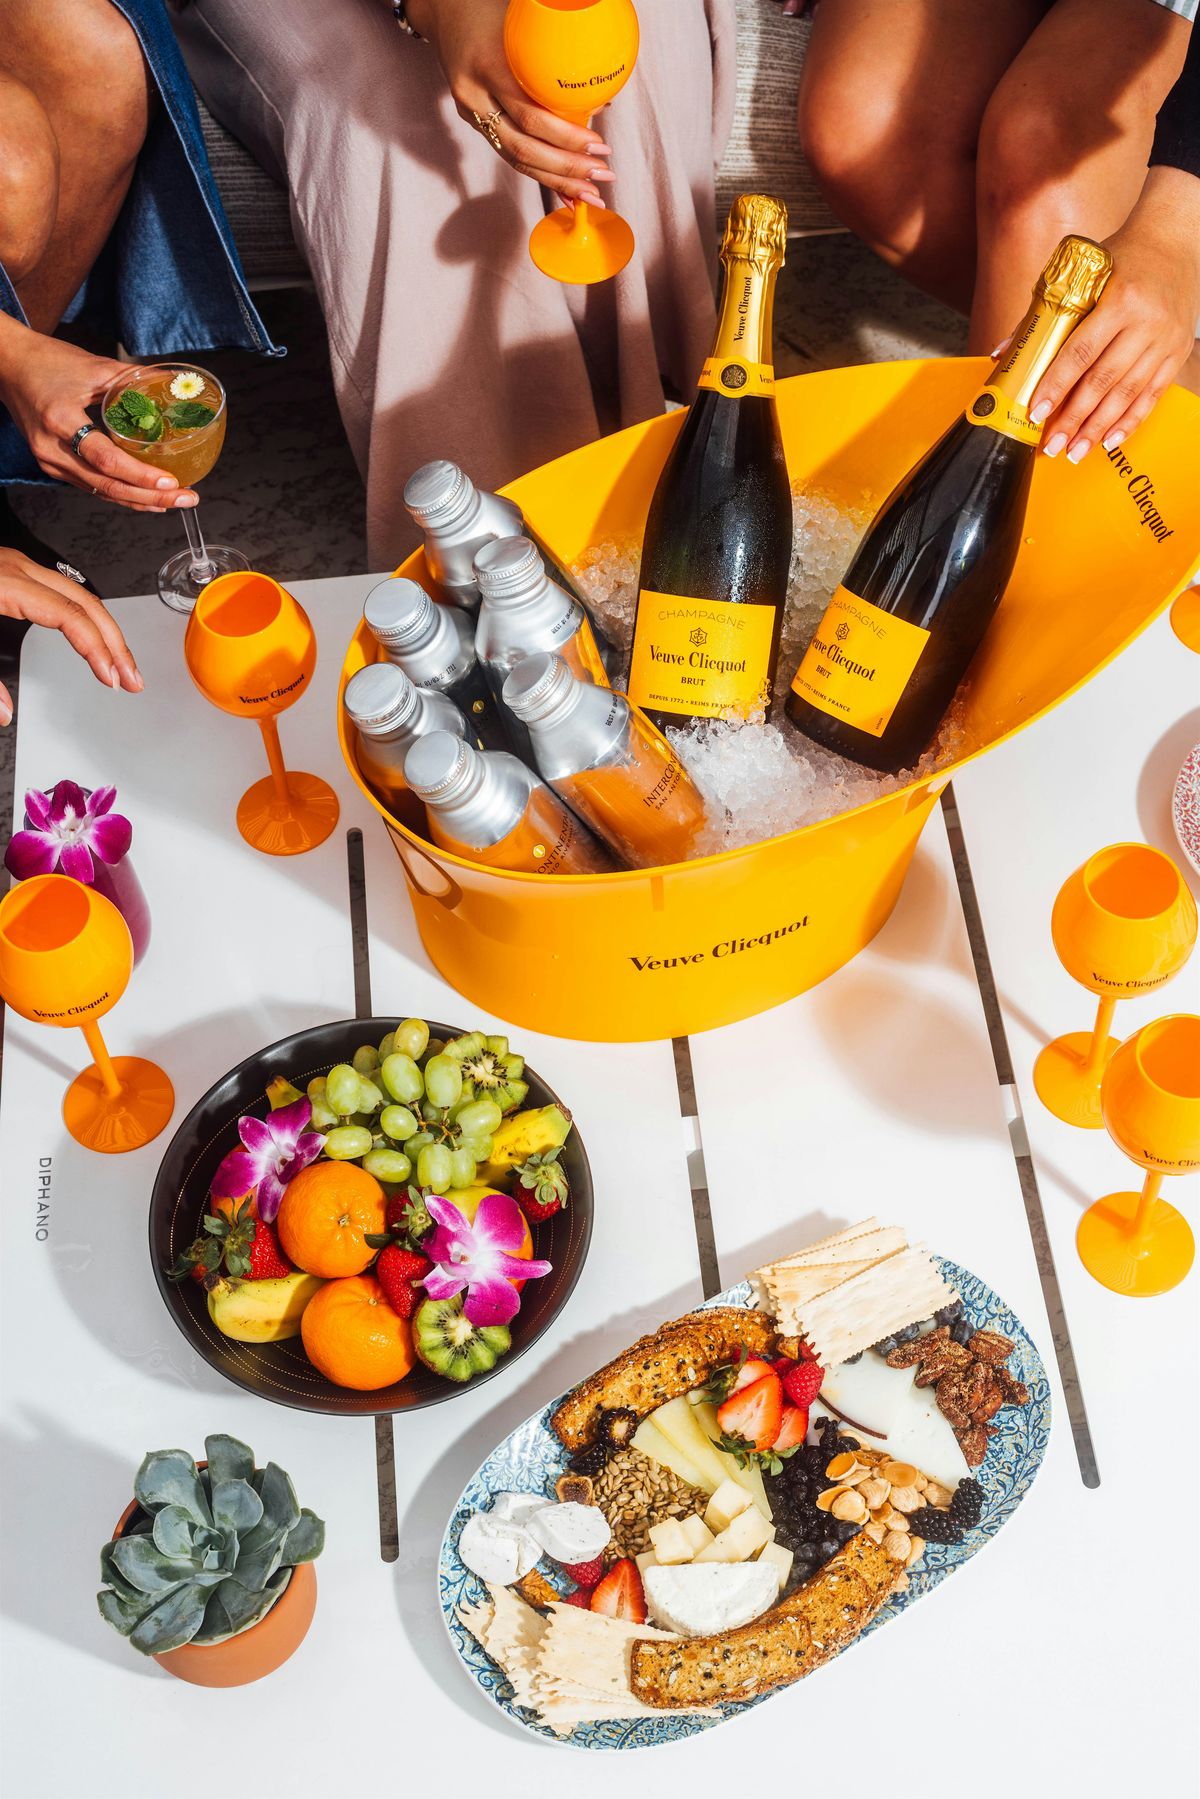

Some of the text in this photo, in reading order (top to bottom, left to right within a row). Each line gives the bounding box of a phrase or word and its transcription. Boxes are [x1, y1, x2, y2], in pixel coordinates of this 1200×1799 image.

[557, 64, 626, 90] Veuve Clicquot
[733, 276, 752, 342] Veuve Clicquot
[1001, 313, 1042, 375] Veuve Clicquot
[1102, 444, 1175, 544] uve Clicquot
[657, 609, 747, 631] CHAMPAGNE
[649, 644, 747, 674] Veuve Clicquot
[815, 664, 832, 680] BRUT
[826, 643, 877, 682] Clicquot
[238, 673, 305, 704] Veuve Clicquot
[680, 676, 706, 687] BRUT
[648, 693, 669, 702] DEPUIS
[813, 688, 827, 701] REIMS
[827, 697, 851, 713] FRANCE
[655, 796, 668, 811] SAN
[628, 915, 810, 972] Veuve Clicquot
[1092, 972, 1123, 987] Veuve
[32, 991, 110, 1018] Veuve Clicquot
[1143, 1149, 1175, 1166] Veuve
[35, 1157, 52, 1242] DIPHANO
